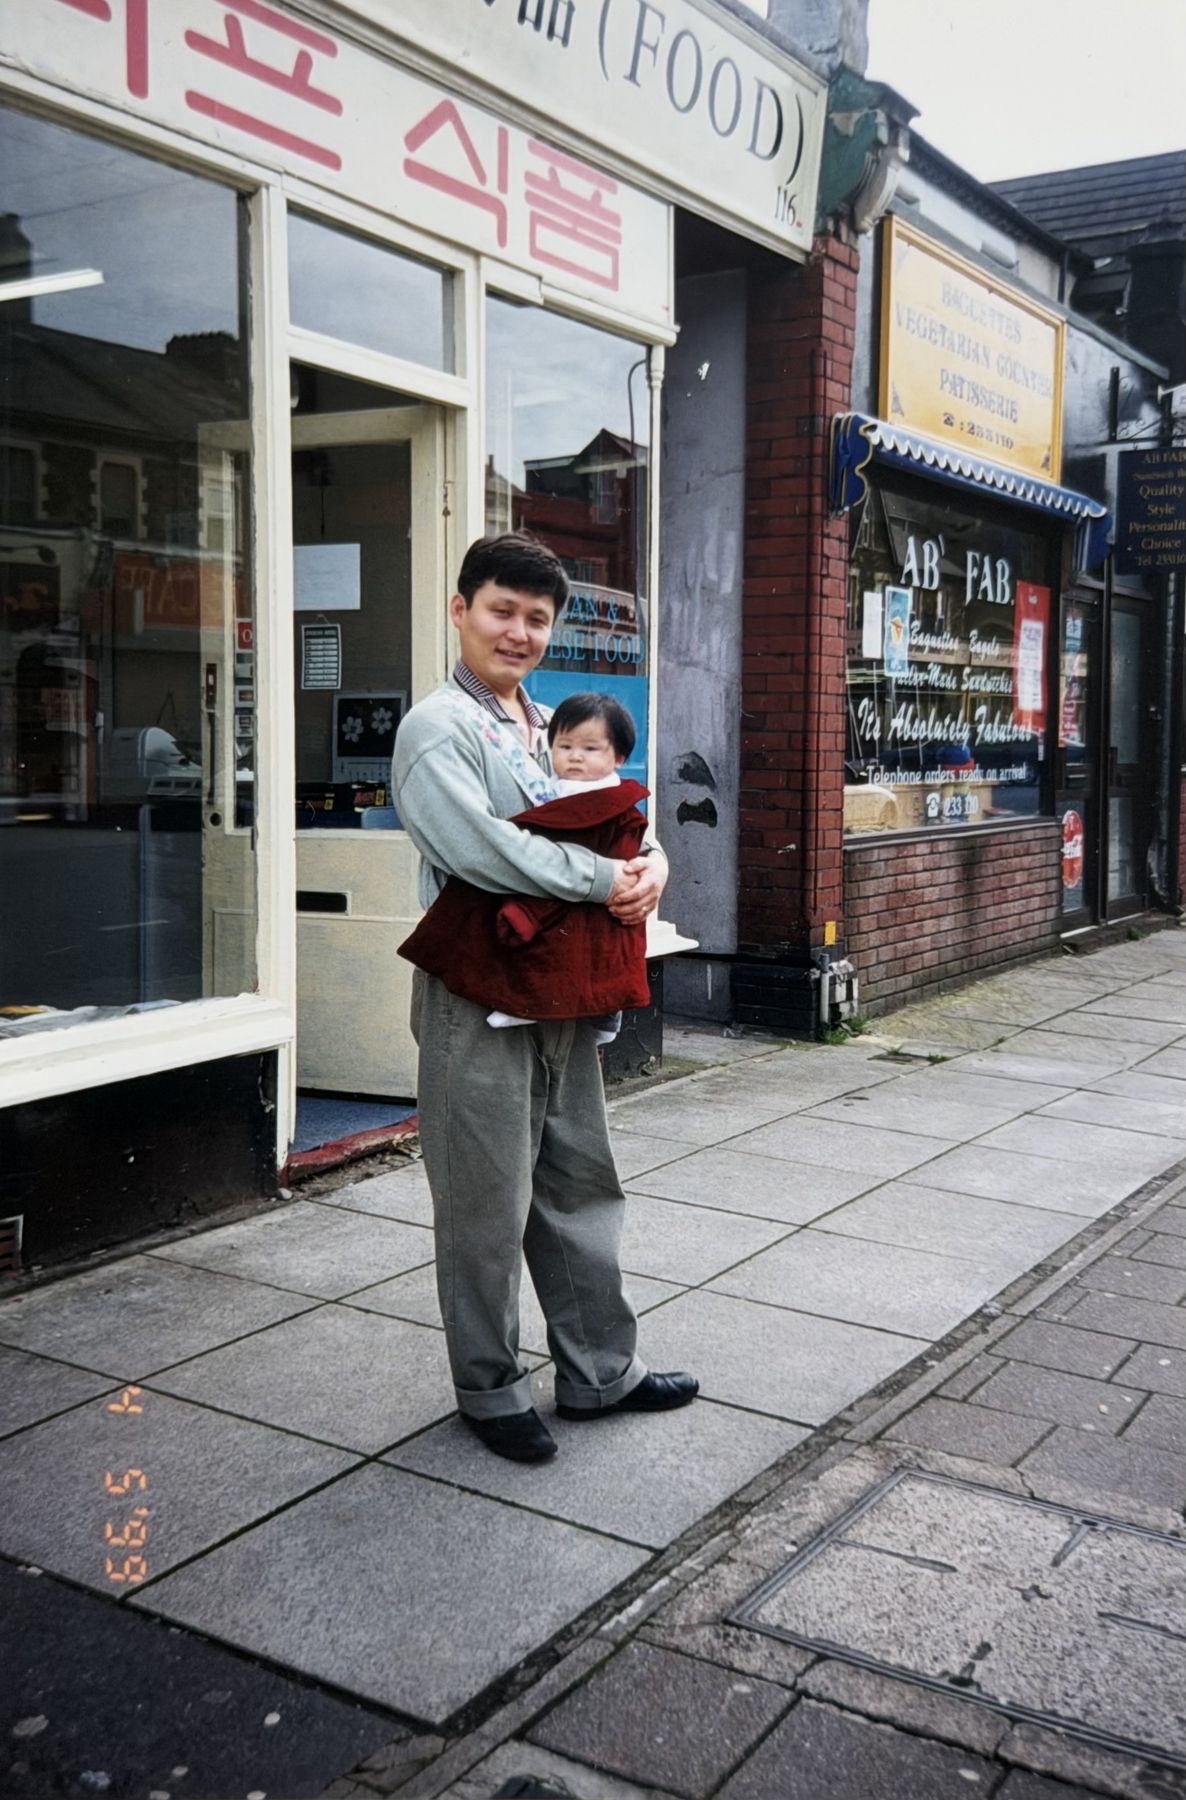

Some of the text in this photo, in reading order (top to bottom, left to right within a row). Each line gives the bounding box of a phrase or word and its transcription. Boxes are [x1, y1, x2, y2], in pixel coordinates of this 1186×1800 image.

[597, 0, 804, 185] (FOOD)
[403, 99, 623, 292] 식품
[895, 300, 991, 369] VEGETARIAN
[939, 368, 1019, 423] PATISSERIE
[1139, 484, 1184, 499] Quality
[1147, 503, 1176, 518] Style
[1129, 519, 1186, 534] Personalit
[1141, 537, 1182, 550] Choice
[560, 592, 618, 624] AN &
[593, 633, 645, 664] FOOD
[910, 620, 960, 654] Baguettes
[969, 629, 999, 661] Bagels
[897, 662, 957, 691] ailor-Made
[887, 702, 970, 751] Absolutely
[866, 762, 1026, 786] Telephone orders ready on arrival
